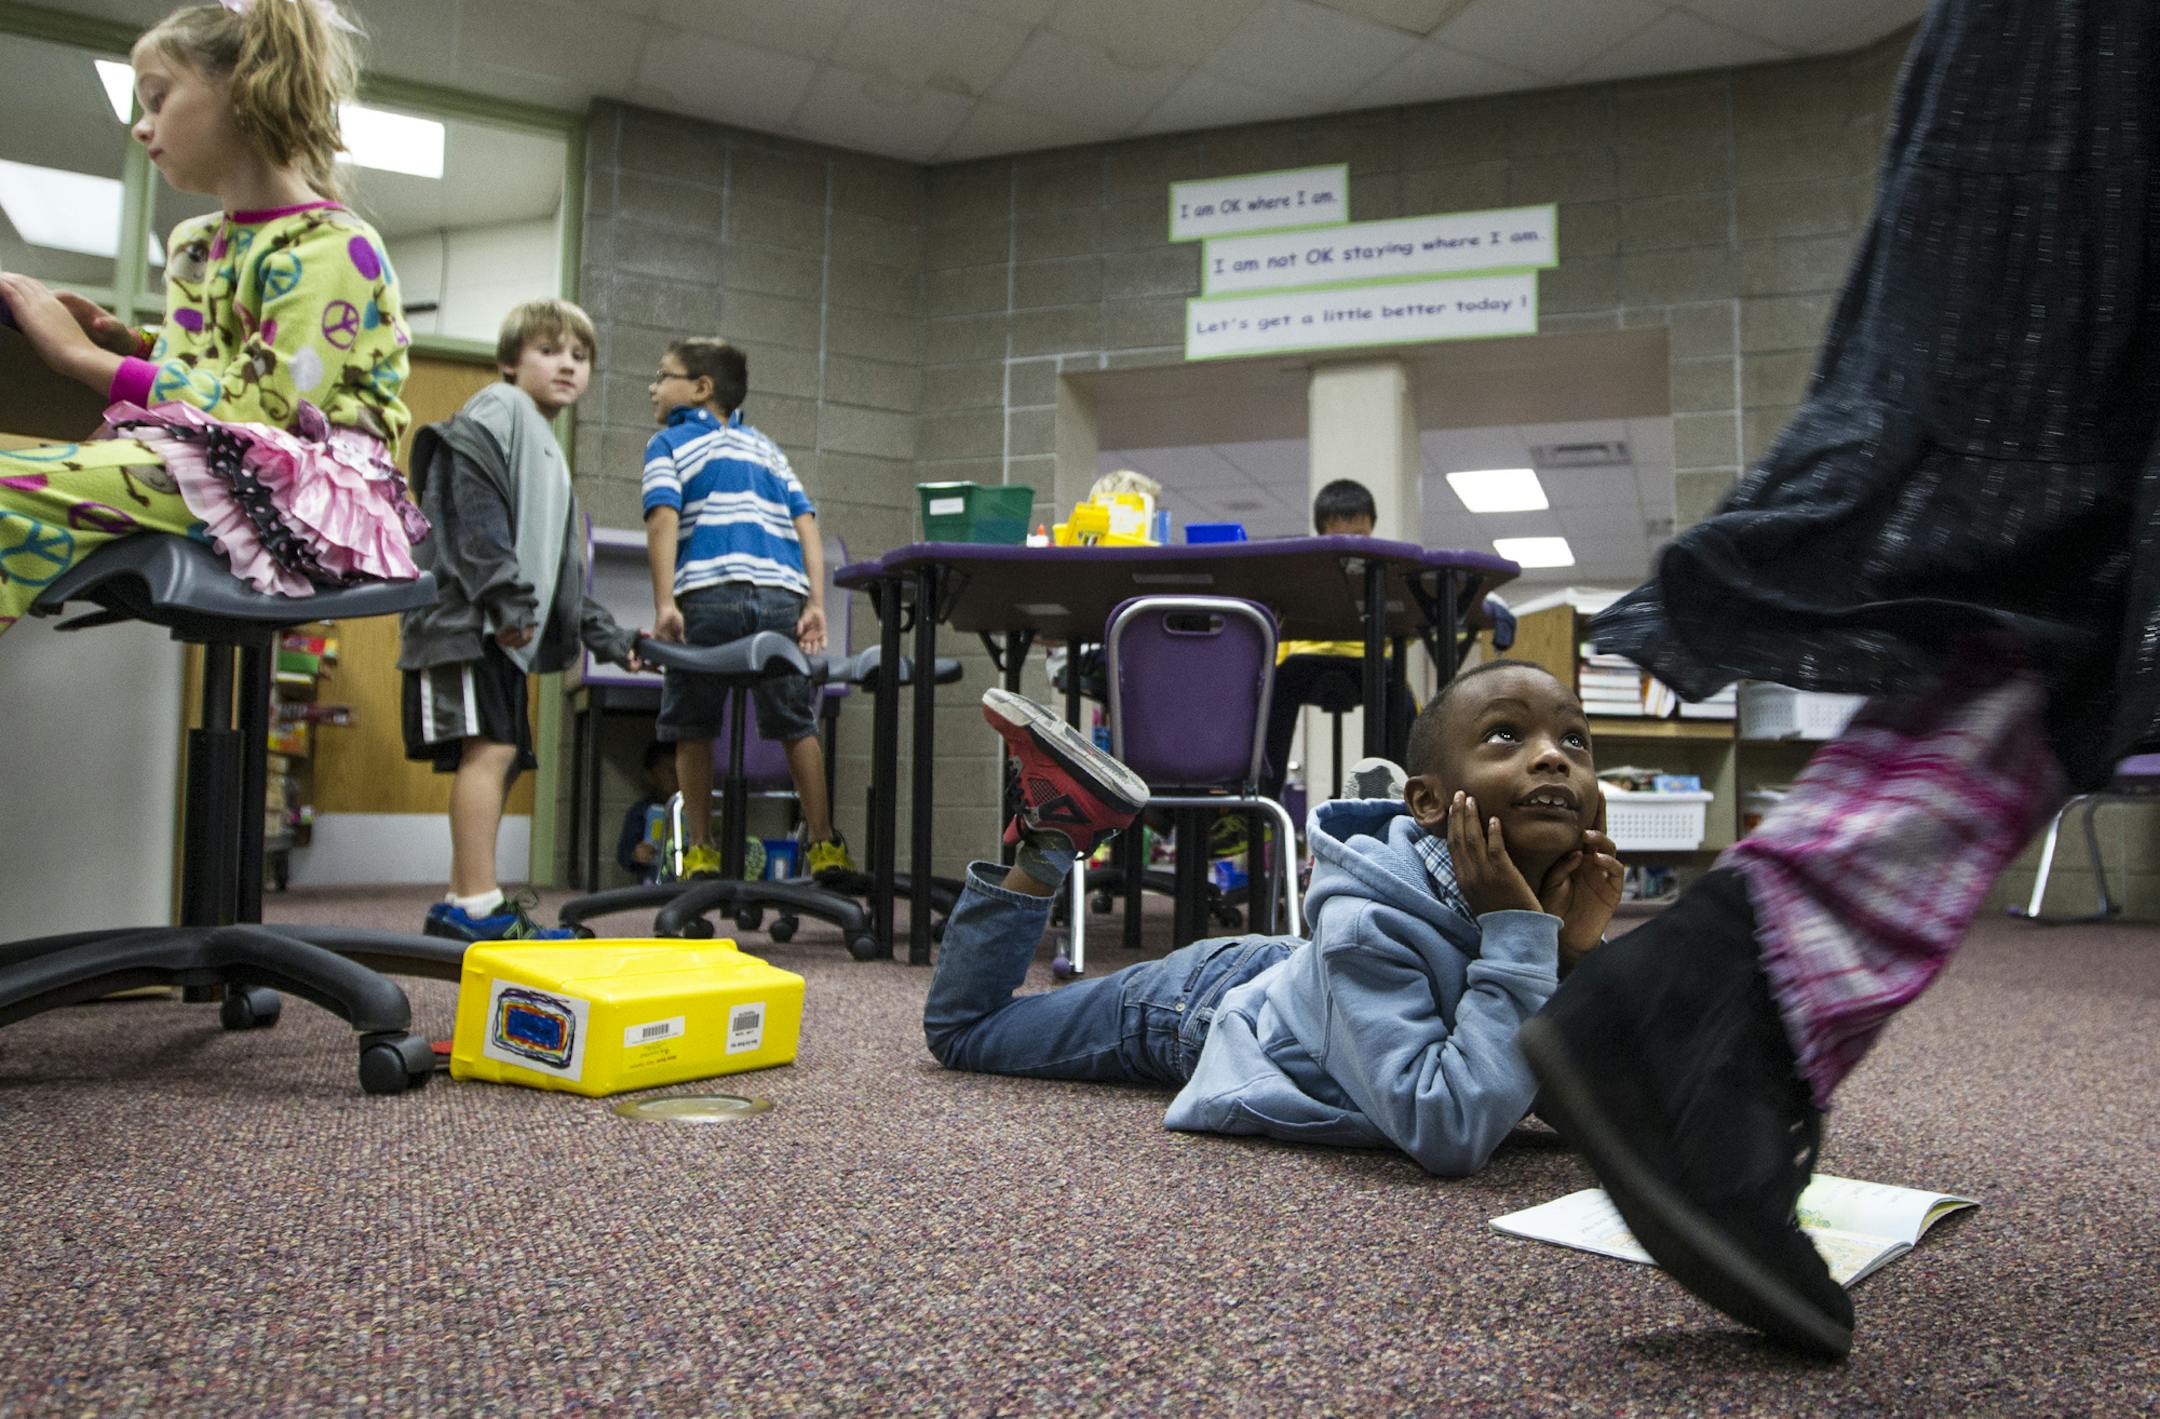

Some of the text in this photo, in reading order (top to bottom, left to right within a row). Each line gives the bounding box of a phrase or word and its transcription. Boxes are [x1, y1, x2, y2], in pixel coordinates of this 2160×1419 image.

[1180, 203, 1189, 219] I
[1194, 203, 1215, 217] am
[1220, 198, 1242, 214] OK
[1247, 194, 1291, 211] where
[1297, 189, 1306, 205] I
[1214, 257, 1225, 274] I
[1232, 258, 1260, 272] am
[1267, 252, 1297, 269] not
[1305, 247, 1334, 265] OK
[1343, 241, 1414, 261] staying
[1421, 235, 1481, 251] where
[1490, 231, 1500, 244] I
[1196, 317, 1249, 335] Let's
[1257, 315, 1292, 331] get
[1301, 314, 1314, 325] a
[1323, 307, 1373, 323] little
[1381, 303, 1447, 318] better
[1455, 297, 1512, 313] today
